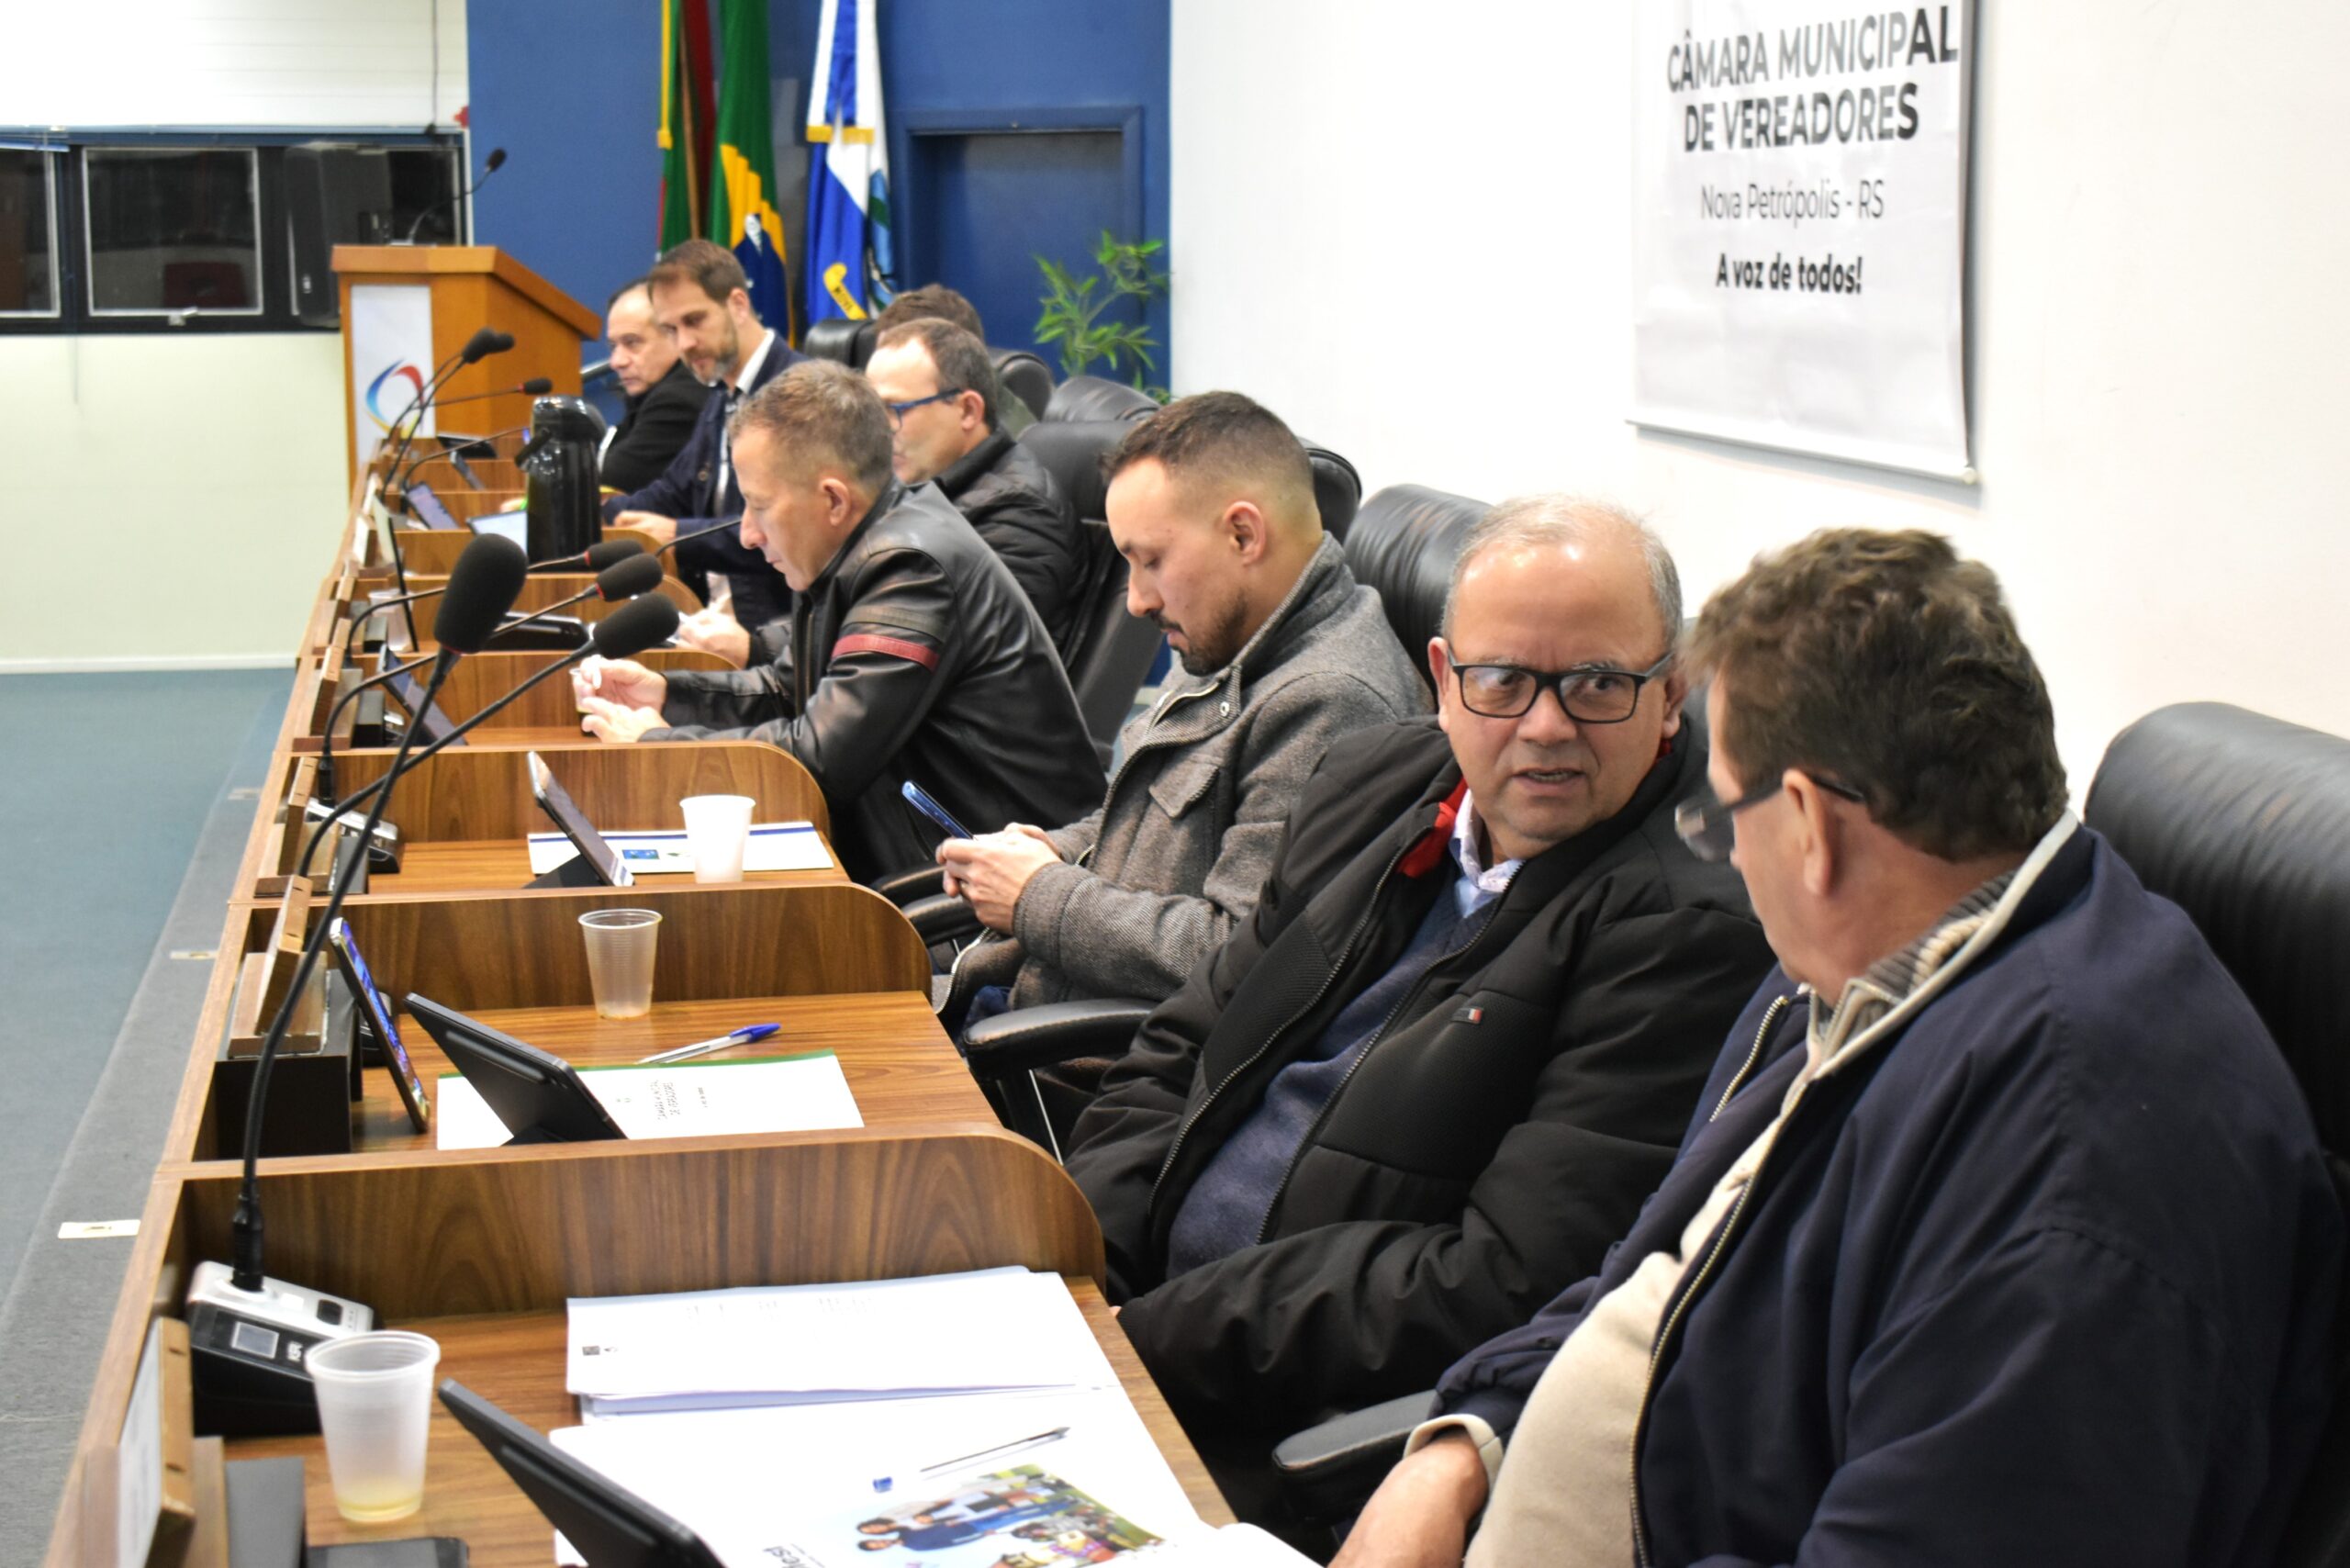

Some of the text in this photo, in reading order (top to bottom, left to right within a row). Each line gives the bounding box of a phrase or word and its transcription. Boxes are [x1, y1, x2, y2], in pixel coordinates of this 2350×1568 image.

[1668, 6, 1958, 93] CÂMARA MUNICIPAL
[1684, 82, 1919, 152] DE VEREADORES
[1701, 185, 1741, 219] Nova
[1747, 179, 1840, 229] Petrópolis
[1859, 179, 1884, 219] RS
[1716, 252, 1863, 294] A voz de todos!
